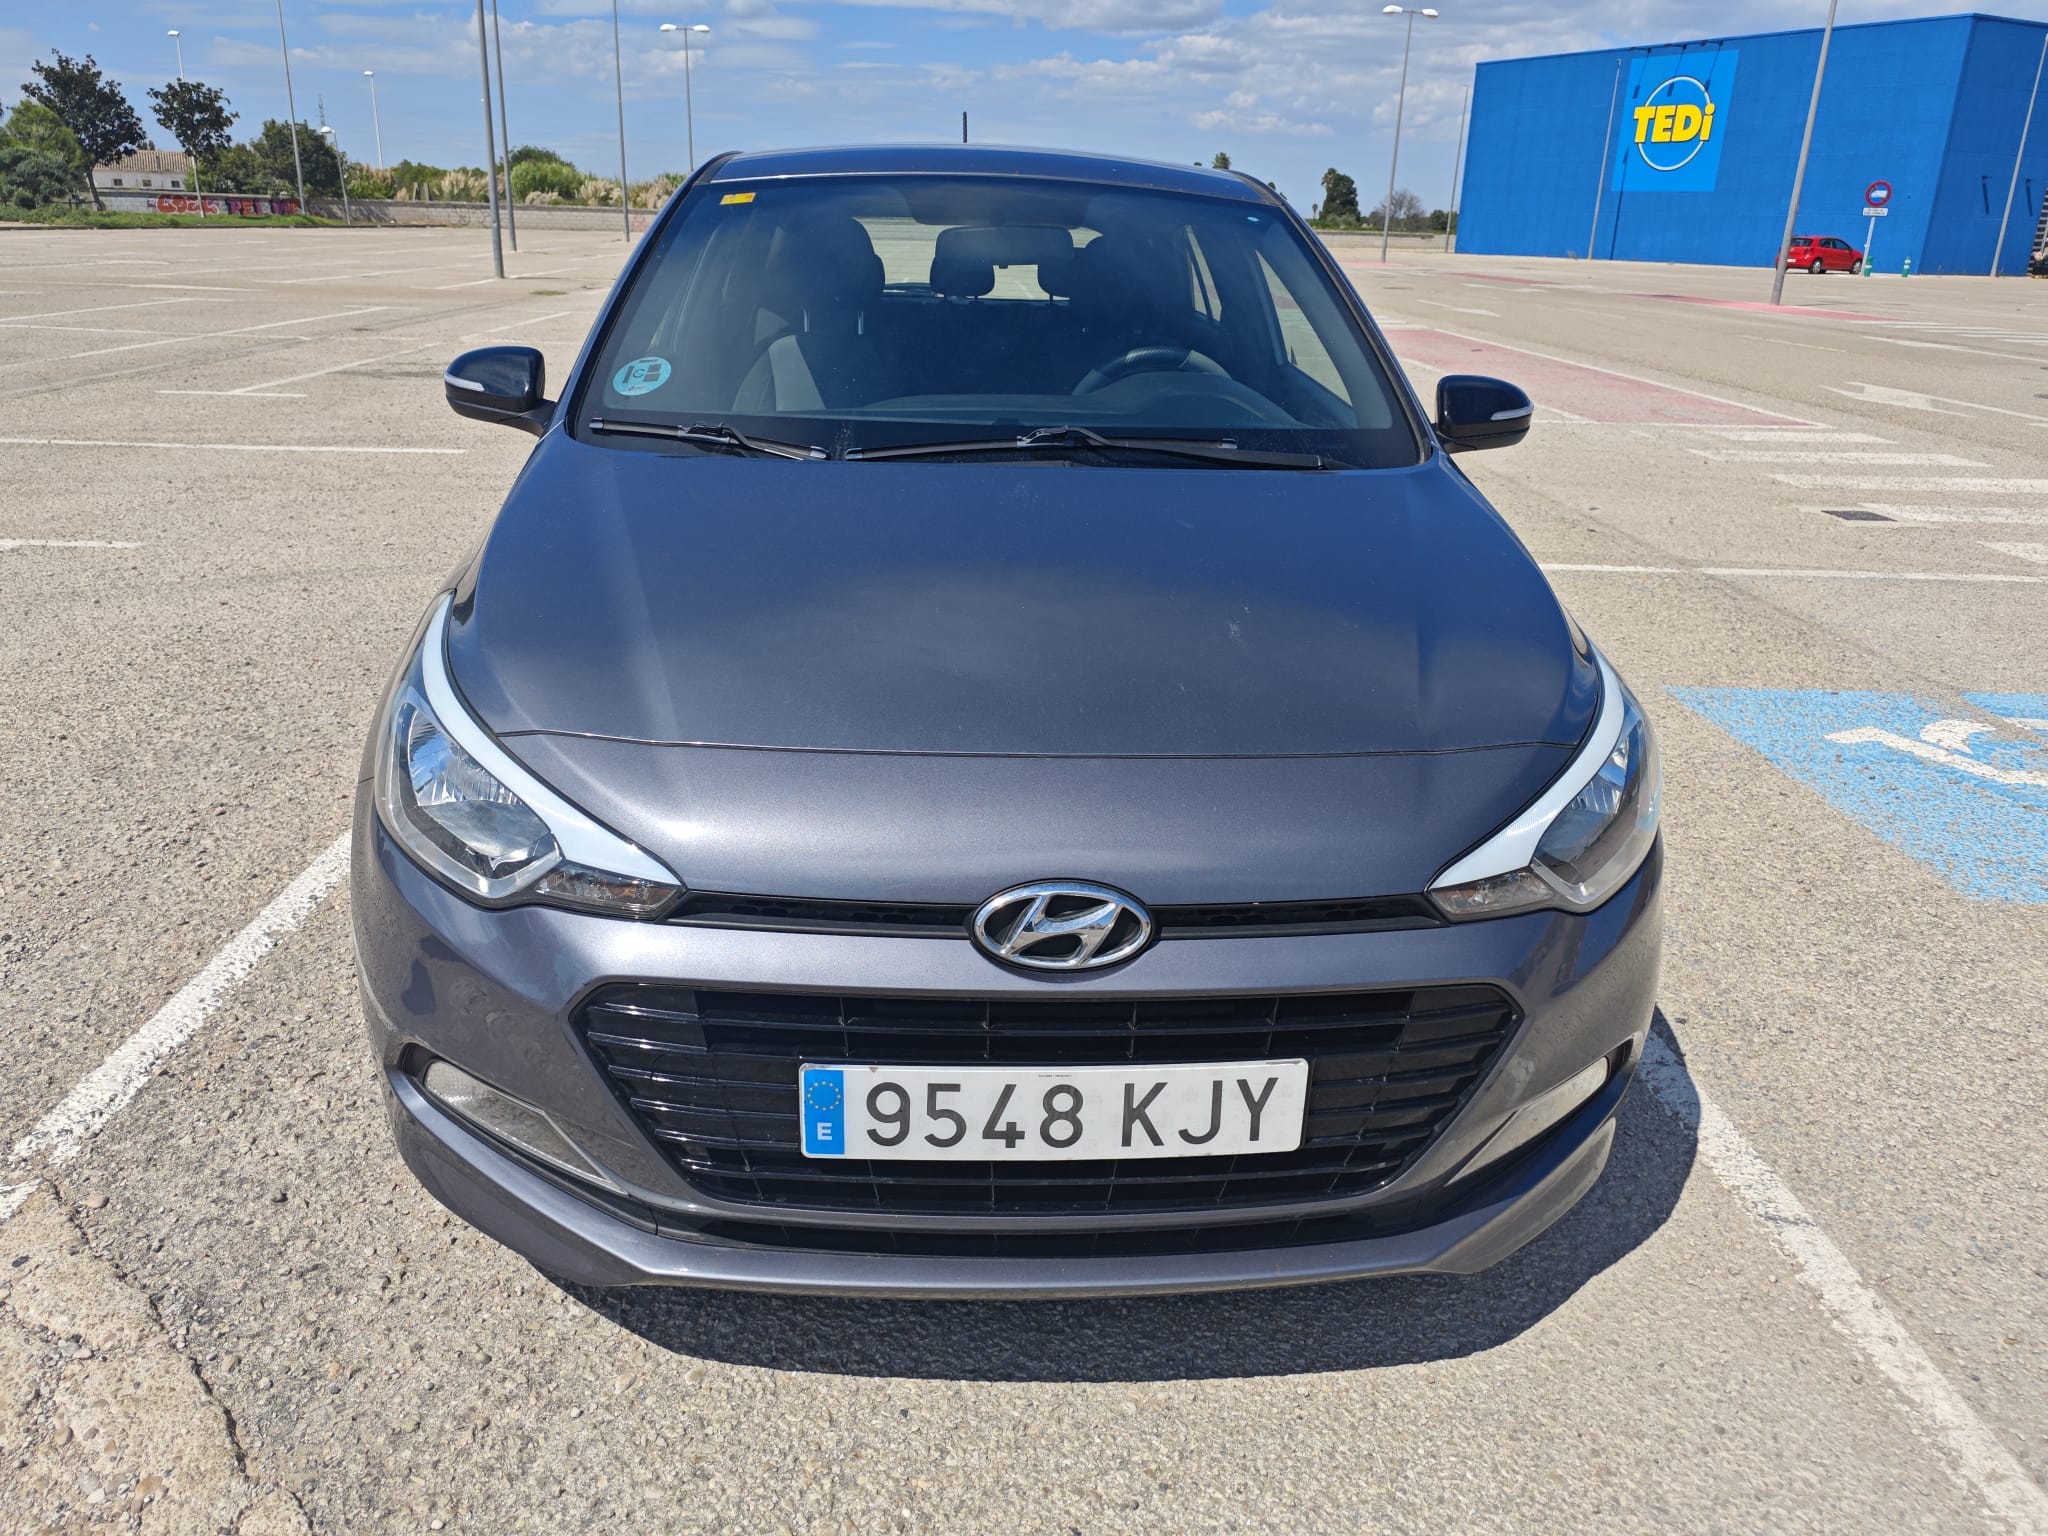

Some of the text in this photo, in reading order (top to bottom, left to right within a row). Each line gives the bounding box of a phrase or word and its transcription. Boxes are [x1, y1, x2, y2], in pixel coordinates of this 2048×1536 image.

[1633, 102, 1716, 143] TEDi
[816, 1122, 833, 1141] E
[866, 1077, 1279, 1149] 9548 KJY
